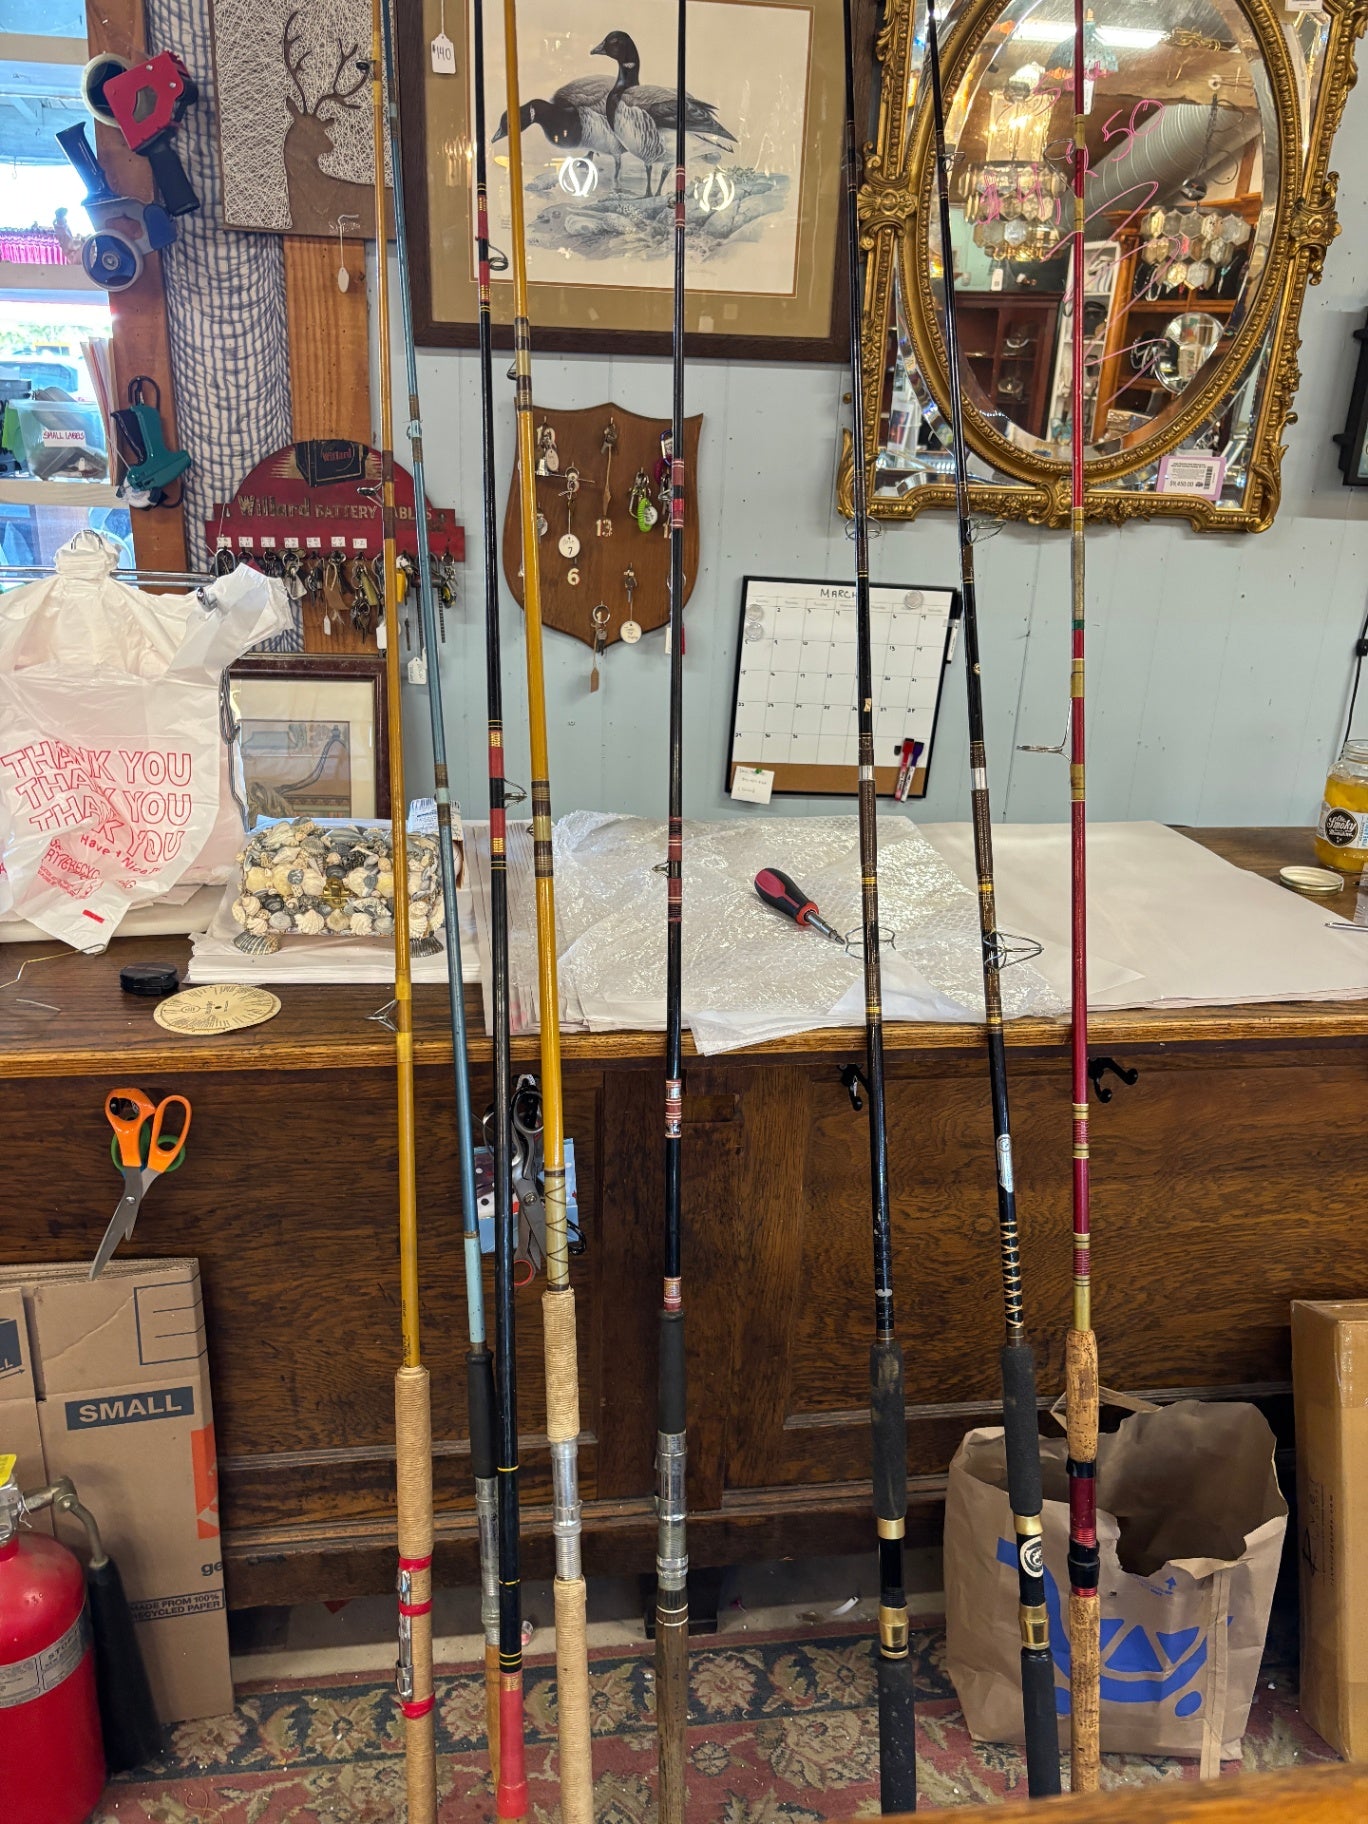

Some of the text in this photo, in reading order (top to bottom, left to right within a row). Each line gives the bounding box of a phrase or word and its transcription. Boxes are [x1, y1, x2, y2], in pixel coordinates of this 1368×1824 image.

[432, 43, 452, 61] $140
[43, 431, 63, 440] SMALL
[238, 495, 311, 517] Willard
[315, 505, 377, 519] BATTERY
[567, 567, 580, 586] 6
[1, 740, 192, 786] THANK YOU
[123, 790, 192, 826] YOU
[1326, 816, 1357, 832] Smoky
[80, 834, 110, 856] Have
[127, 826, 185, 862] YOU
[78, 1394, 182, 1423] SMALL
[131, 1593, 219, 1611] MADE FROM 100%
[187, 1601, 220, 1612] PAPER
